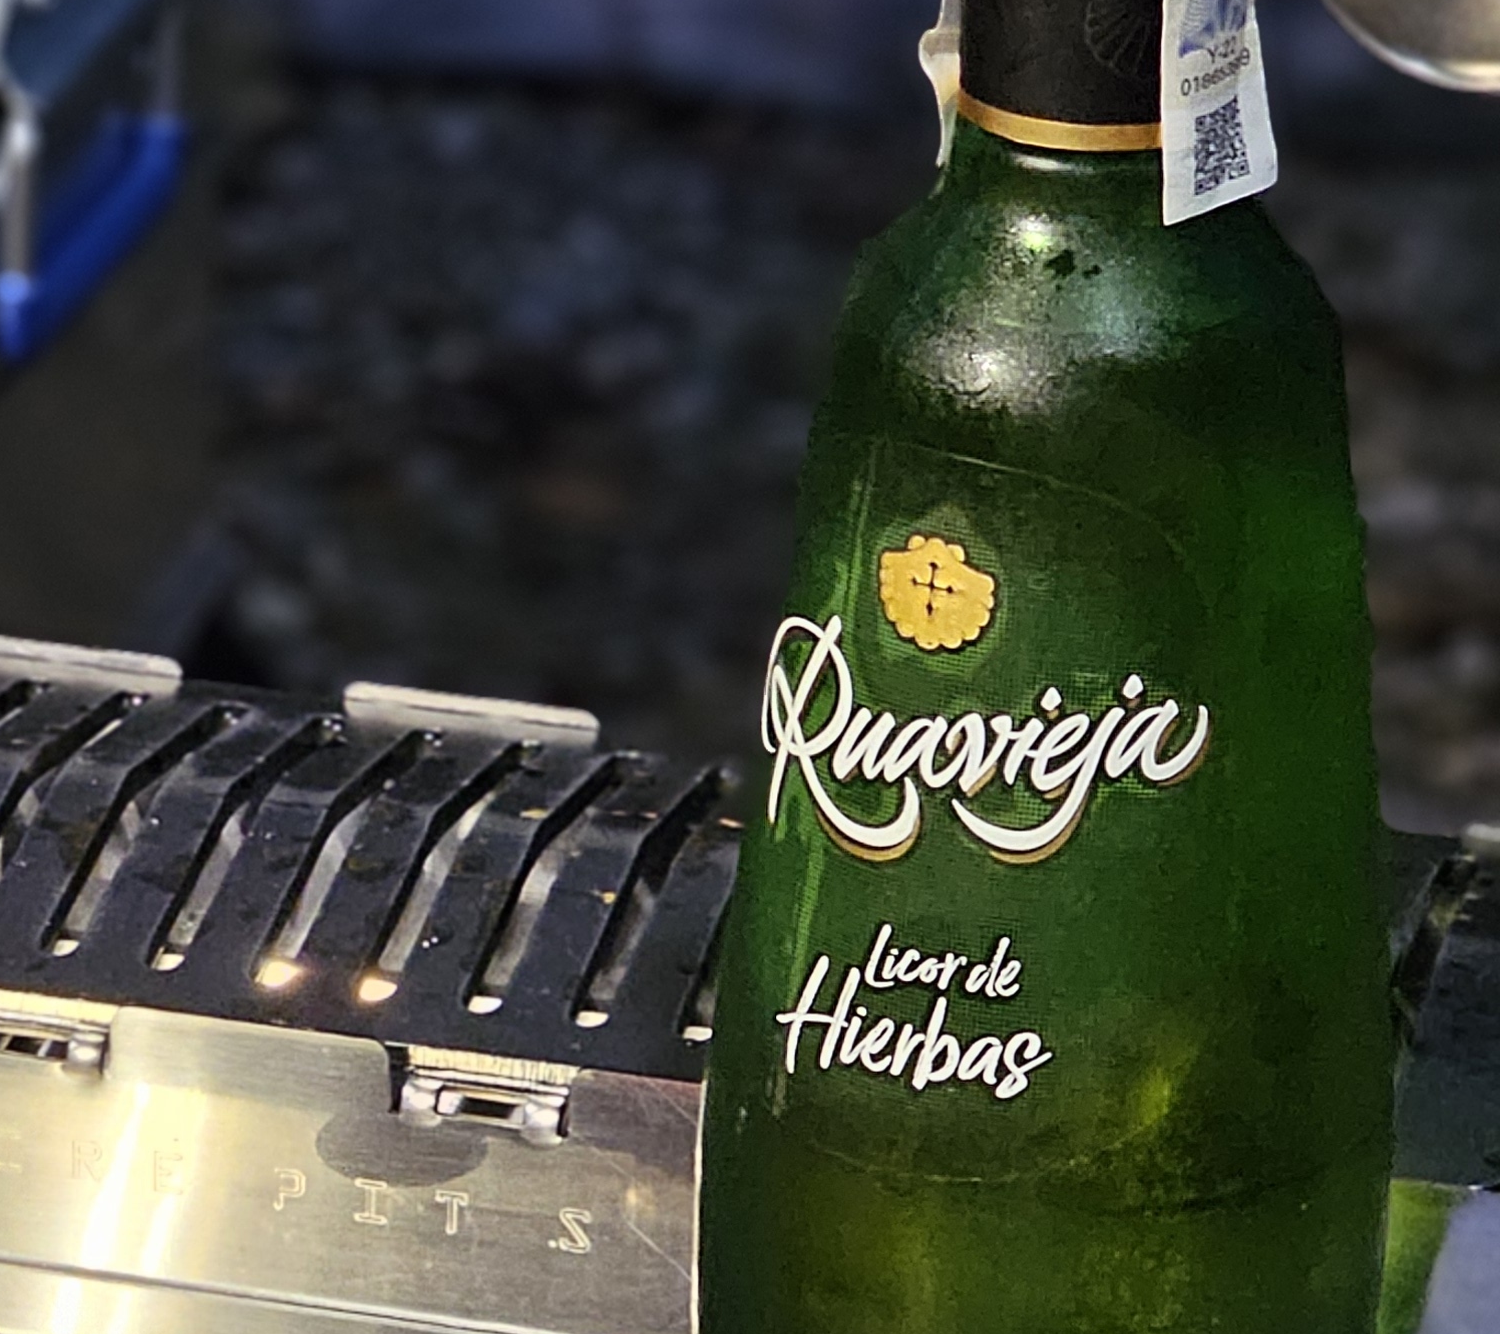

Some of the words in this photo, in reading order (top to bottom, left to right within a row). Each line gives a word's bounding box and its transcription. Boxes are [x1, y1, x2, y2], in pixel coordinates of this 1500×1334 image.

[761, 614, 1210, 857] Ruavieja
[775, 955, 1053, 1100] Hierbas
[865, 923, 967, 990] Licor
[966, 936, 1022, 998] de
